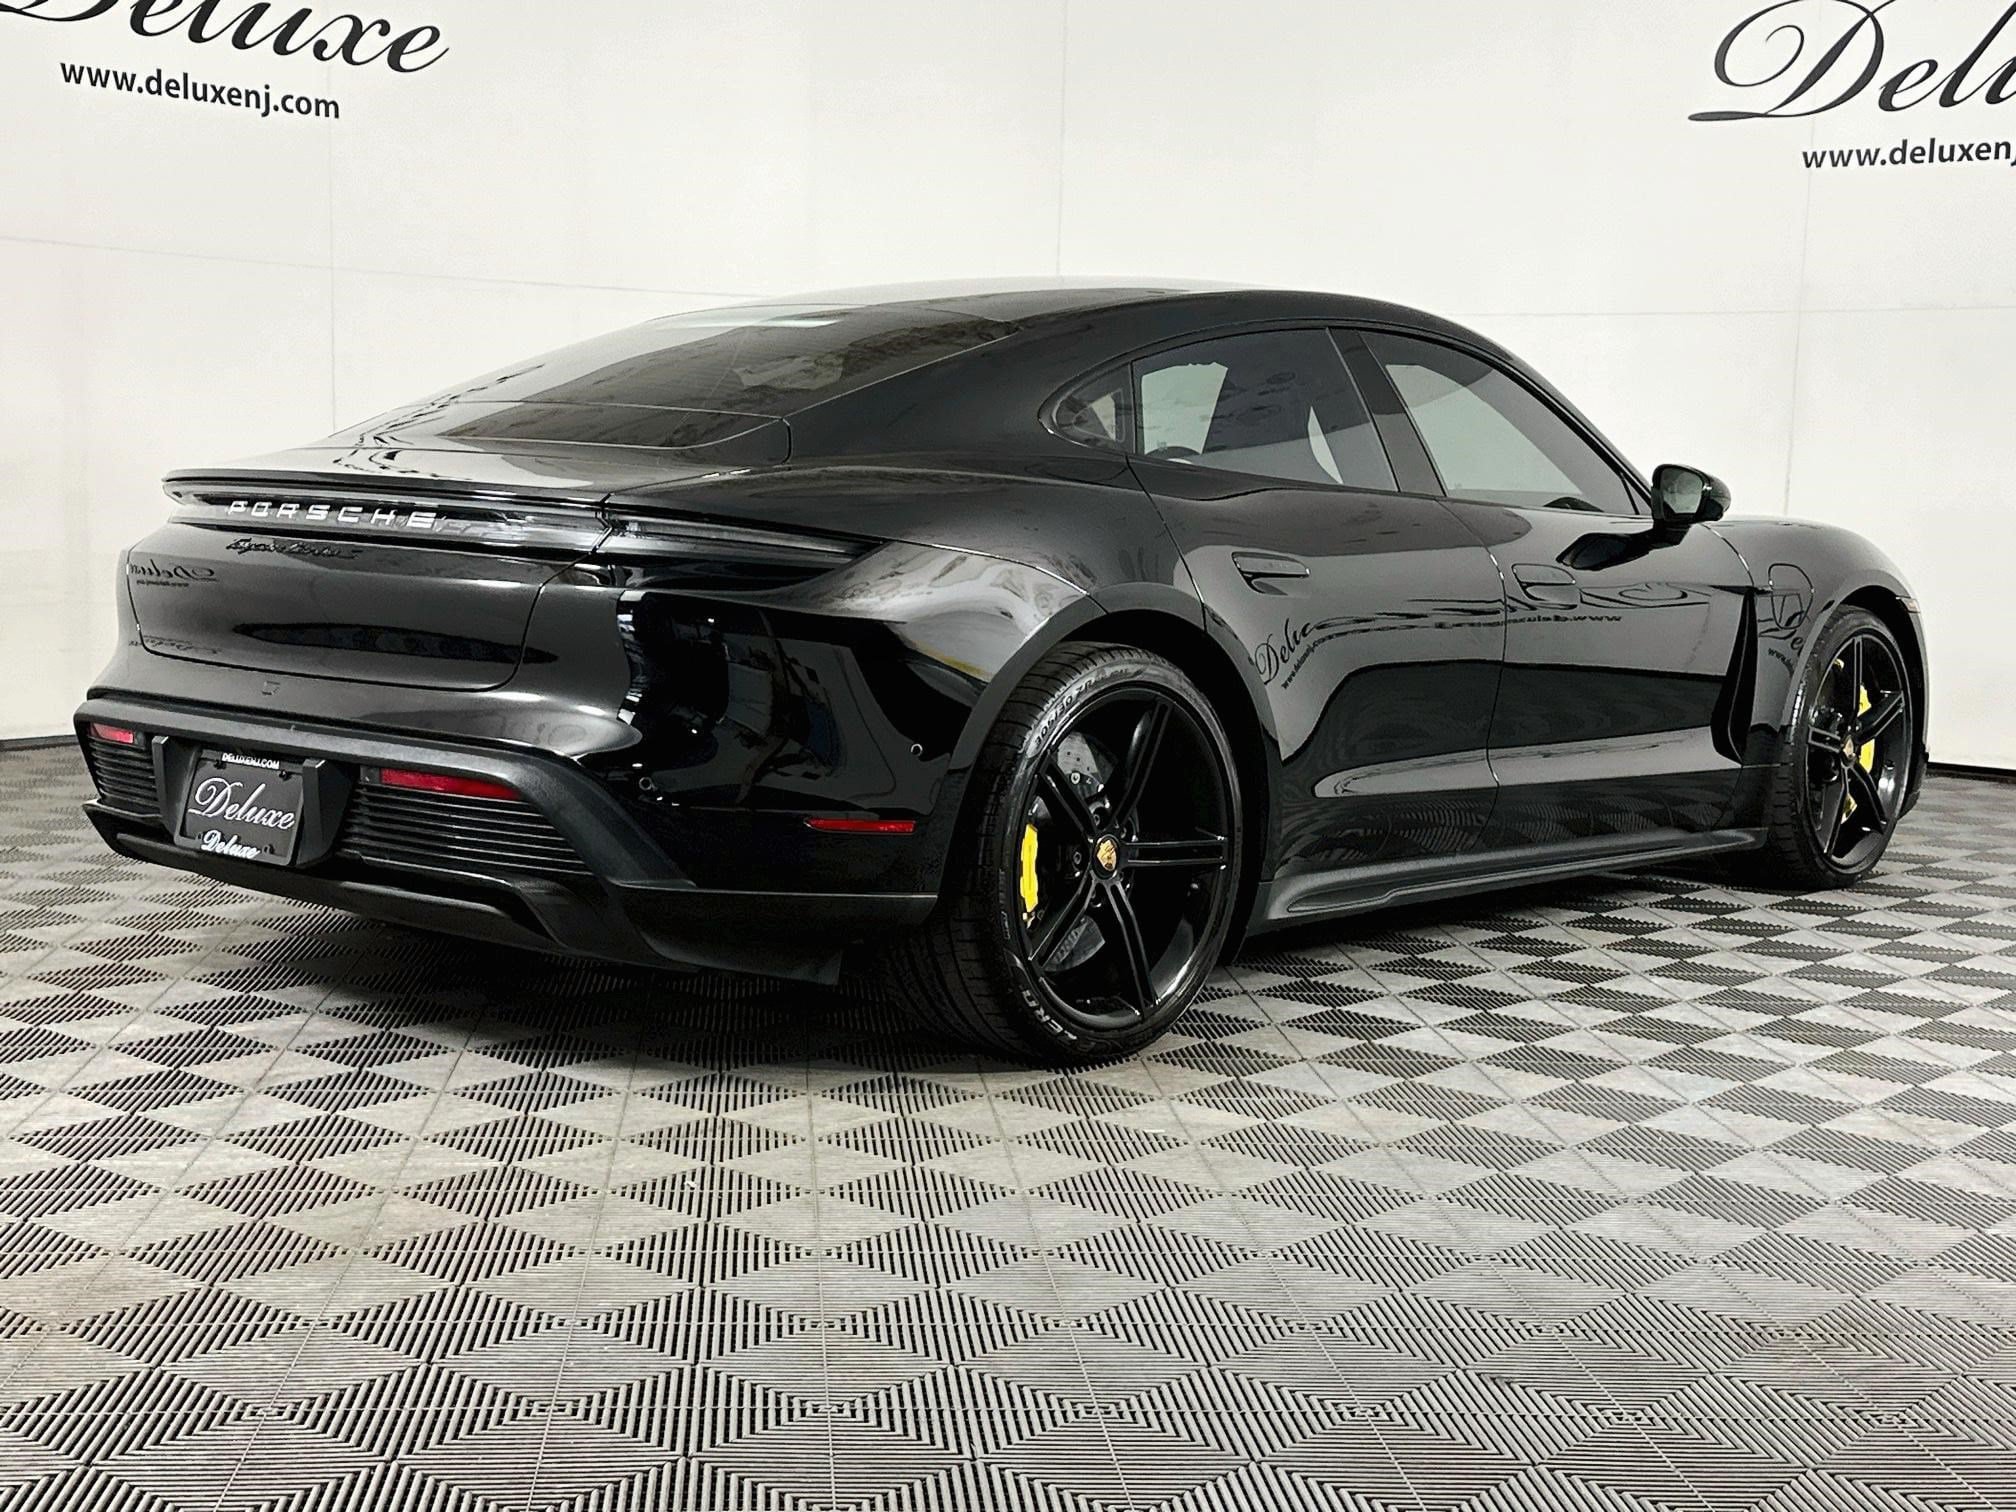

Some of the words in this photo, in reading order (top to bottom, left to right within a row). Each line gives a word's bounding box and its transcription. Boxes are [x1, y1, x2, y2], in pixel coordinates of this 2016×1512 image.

[0, 0, 450, 73] euxe
[60, 61, 340, 119] www.deluxenj.com
[227, 499, 437, 529] PORSCHE
[221, 752, 280, 770] DELUXENJ.COM
[188, 777, 295, 830] Deluxe
[200, 829, 261, 860] Deluxe
